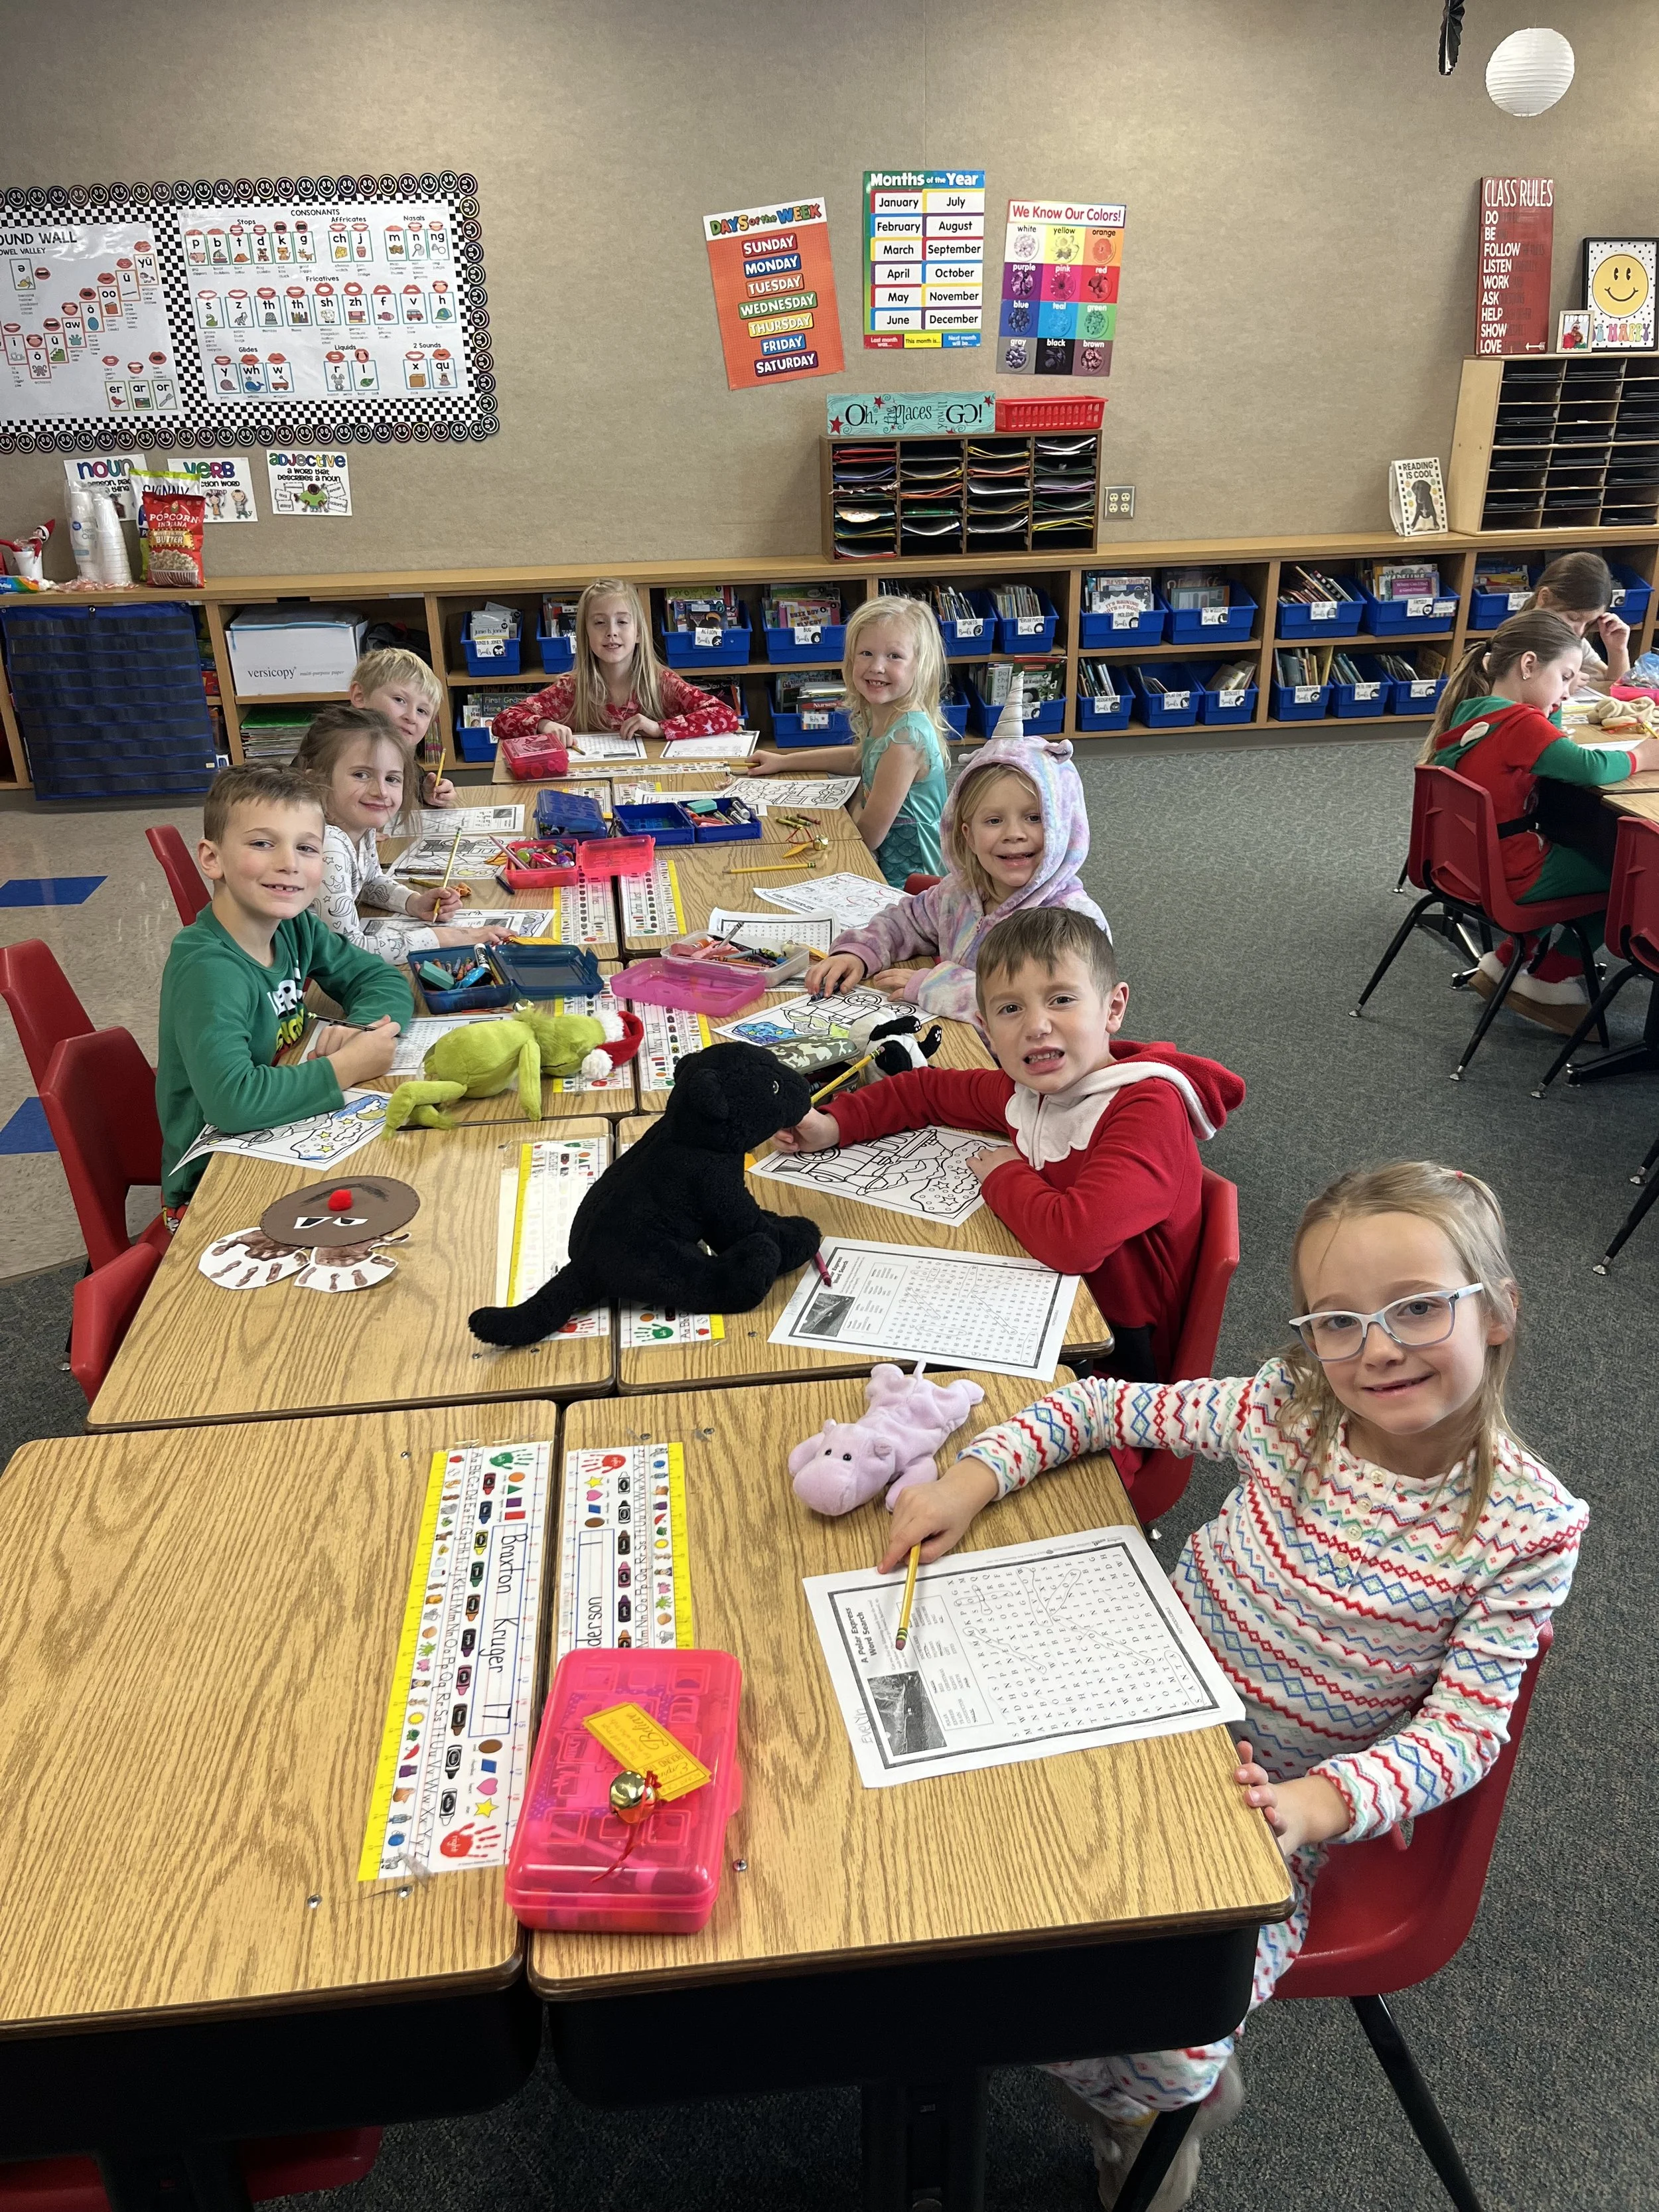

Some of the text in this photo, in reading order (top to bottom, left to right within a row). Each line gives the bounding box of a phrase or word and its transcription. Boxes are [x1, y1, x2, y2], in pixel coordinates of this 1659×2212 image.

[870, 173, 924, 187] Months
[946, 173, 979, 186] Year
[1484, 179, 1553, 207] CLASS RULES
[879, 198, 918, 209] January
[946, 197, 966, 208] July
[710, 203, 822, 236] DAYS of the WEEK
[1013, 205, 1121, 222] We Know Our Colors!
[1485, 210, 1498, 225] DO
[877, 222, 920, 233] February
[939, 221, 972, 232] August
[38, 232, 77, 244] WALL
[332, 234, 346, 244] ch
[431, 233, 445, 244] ng
[1484, 226, 1496, 241] BE
[743, 235, 795, 255] SUNDAY
[883, 245, 914, 254] March
[928, 244, 981, 256] September
[1484, 242, 1520, 257] FOLLOW
[745, 256, 798, 275] MONDAY
[1013, 263, 1036, 271] purple
[1483, 259, 1512, 273] LISTEN
[887, 269, 909, 280] April
[935, 268, 974, 277] October
[748, 275, 801, 295] TUESDAY
[1483, 275, 1509, 289] WORK
[349, 297, 362, 307] zh
[888, 293, 909, 303] May
[930, 291, 979, 301] November
[1482, 291, 1499, 305] ASK
[263, 301, 275, 310] th
[291, 300, 304, 309] th
[321, 298, 334, 308] sh
[740, 294, 814, 316] WEDNESDAY
[887, 315, 909, 325] June
[930, 315, 978, 324] December
[1482, 307, 1503, 322] HELP
[749, 315, 812, 334] THURSDAY
[1480, 323, 1507, 337] SHOW
[1607, 324, 1650, 342] HAPPY
[763, 336, 803, 352] FRIDAY
[1480, 339, 1502, 353] LOVE
[436, 362, 450, 372] qu
[756, 353, 815, 374] SATURDAY
[243, 366, 260, 375] wh
[109, 385, 122, 394] er
[133, 384, 146, 392] ar
[157, 383, 170, 392] or
[845, 404, 878, 427] Oh,
[1403, 461, 1433, 471] READING
[149, 514, 199, 524] POPCORN
[478, 1534, 528, 1718] Braxton Kruger 17
[846, 1607, 858, 1634] Express
[857, 1611, 877, 1656] Word Search
[855, 1636, 865, 1655] Polar
